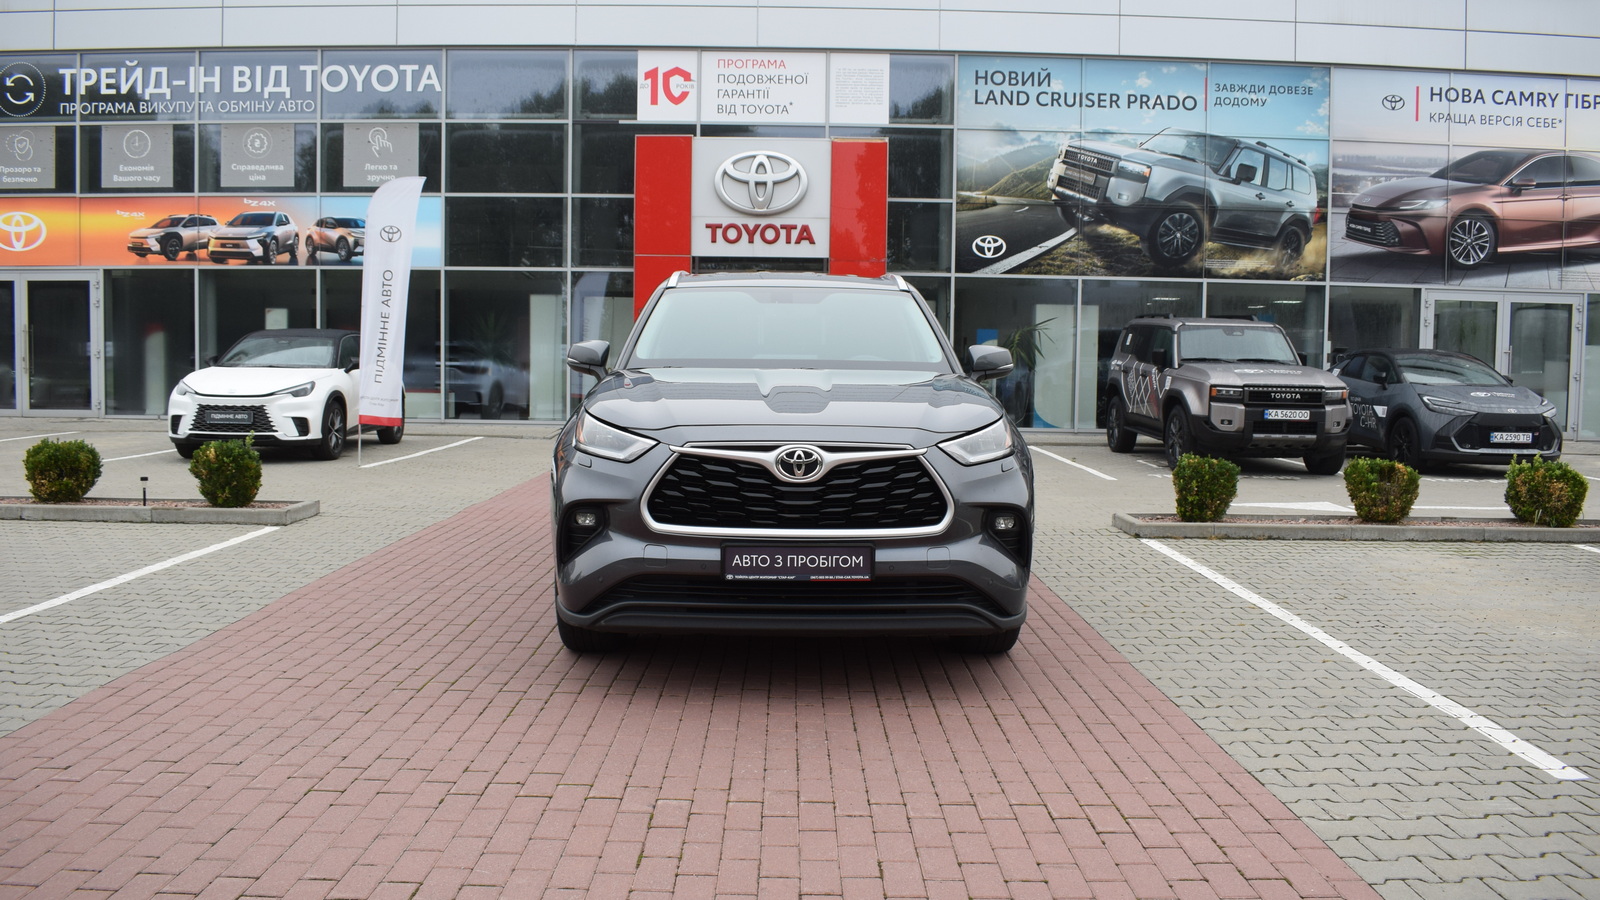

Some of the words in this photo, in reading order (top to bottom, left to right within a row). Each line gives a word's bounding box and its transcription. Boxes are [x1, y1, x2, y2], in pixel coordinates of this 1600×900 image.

[717, 58, 787, 69] ПРОГРАМА
[58, 60, 221, 100] ТРЕЙД-ІН
[233, 65, 291, 99] ВІД
[299, 64, 442, 92] TOYOTA
[717, 72, 809, 86] ПОДОВЖЕНОЇ
[974, 67, 1051, 87] НОВИЙ
[717, 87, 770, 99] ГАРАНТІЇ
[1214, 83, 1265, 95] ЗАВЖДИ
[1268, 85, 1314, 95] ДОВЕЗЕ
[974, 89, 1030, 106] LAND
[1036, 91, 1120, 109] CRUISER
[1127, 93, 1198, 111] PRADO
[1213, 96, 1267, 108] ДОДОМУ
[1429, 86, 1486, 104] НОВА
[1491, 89, 1559, 108] CAMRY
[60, 102, 136, 115] ПРОГРАМА
[139, 101, 195, 114] ВИКУПУ
[198, 101, 214, 113] ТА
[218, 100, 274, 113] ОБМІНУ
[277, 99, 315, 112] АВТО
[717, 104, 737, 115] ВІД
[1429, 112, 1476, 126] КРАЩА
[1480, 114, 1523, 127] ВЕРСІЯ
[1077, 153, 1098, 164] TOYOTA
[119, 164, 154, 172] Економія
[231, 163, 284, 172] Справедлива
[364, 163, 387, 171] Легко
[2, 175, 38, 183] безпечно
[113, 174, 142, 182] Вашого
[144, 174, 161, 183] часу
[248, 173, 266, 182] ціна
[366, 173, 396, 182] зручно
[705, 222, 816, 245] TOYOTA
[381, 269, 394, 308] АВТО
[374, 311, 390, 384] ПІДМІННЕ
[1268, 410, 1279, 418] KA
[1280, 410, 1297, 419] 5620
[1360, 415, 1377, 429] C-HR
[1505, 433, 1521, 441] 2590
[732, 554, 770, 567] АВТО
[774, 555, 783, 567] З
[787, 555, 863, 567] ПРОБІГОМ
